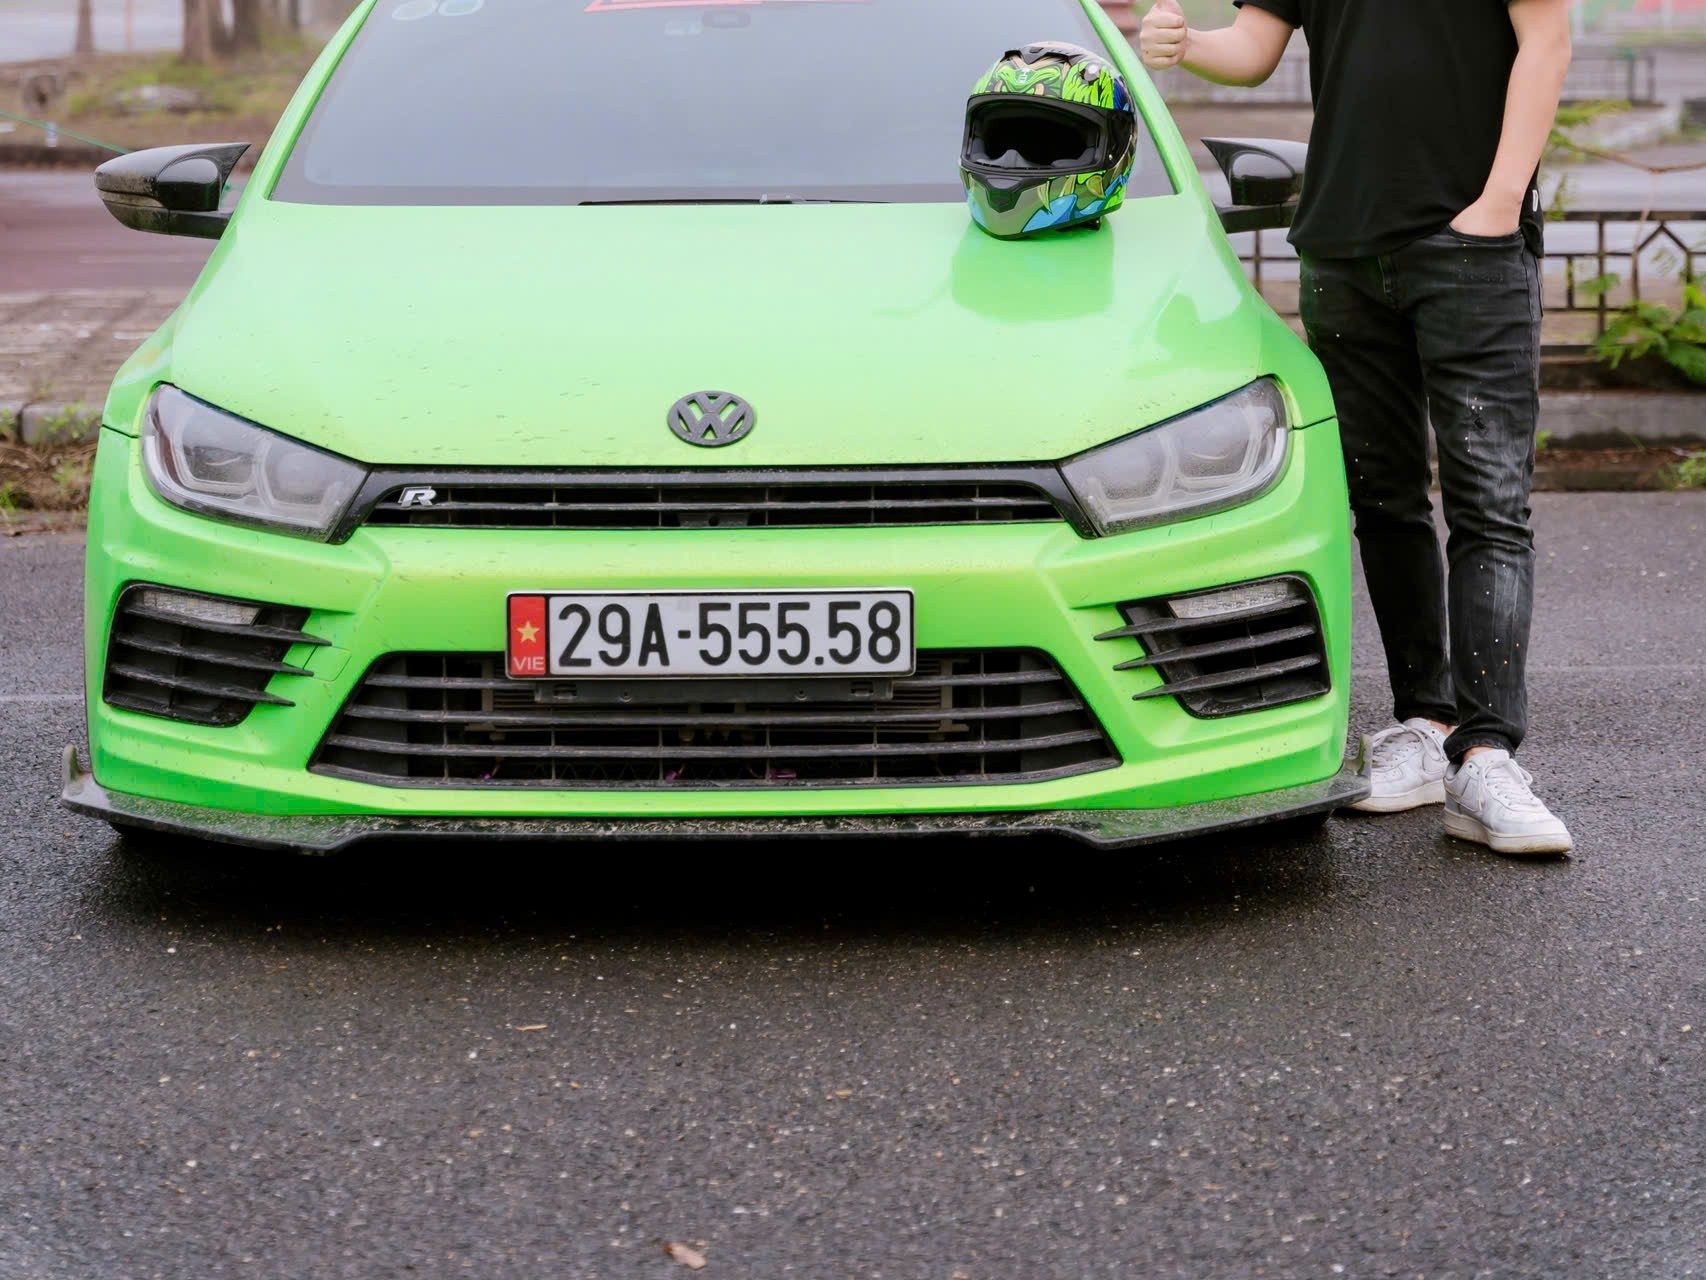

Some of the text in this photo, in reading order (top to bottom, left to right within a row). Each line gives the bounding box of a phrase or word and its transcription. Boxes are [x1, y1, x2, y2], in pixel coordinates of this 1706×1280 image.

[399, 486, 437, 507] R
[558, 600, 901, 667] 29A-555.58
[513, 656, 545, 671] VIE
